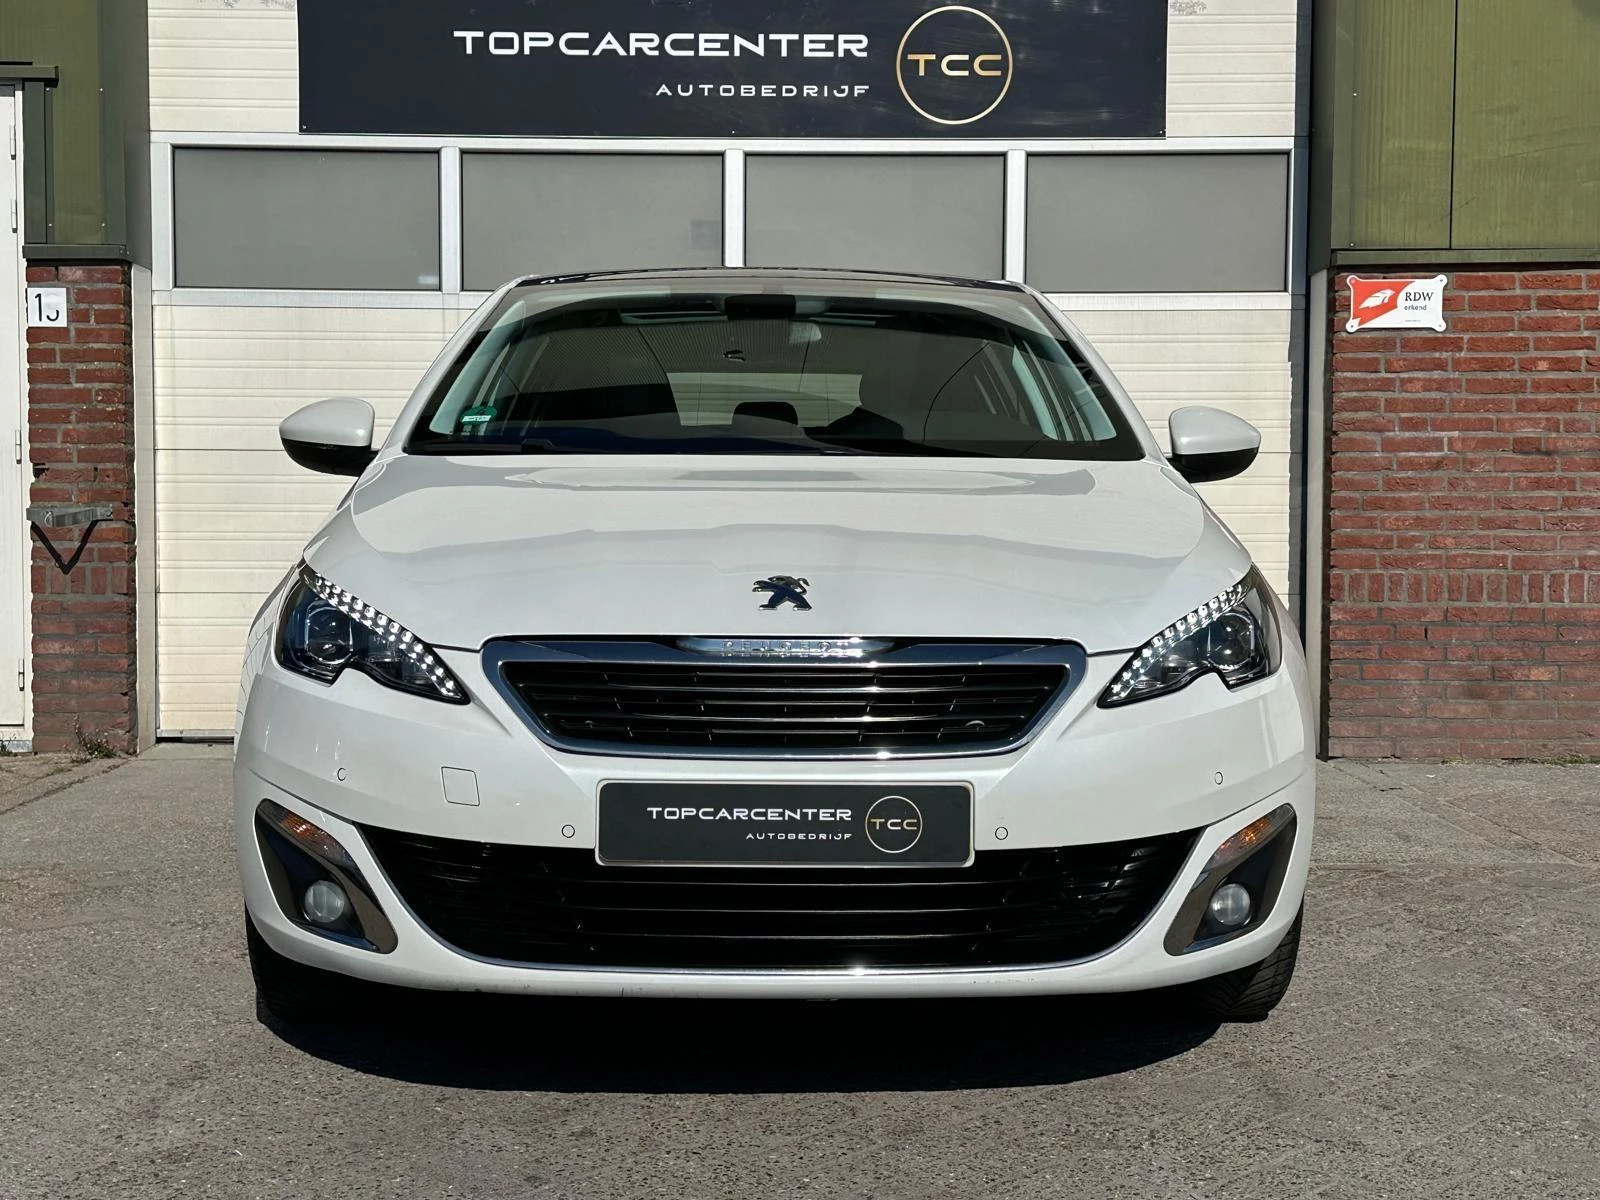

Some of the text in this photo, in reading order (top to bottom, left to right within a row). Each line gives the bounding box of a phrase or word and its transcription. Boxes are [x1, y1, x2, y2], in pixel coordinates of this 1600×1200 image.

[453, 30, 868, 58] TOPCARCENTER
[906, 53, 1002, 77] TCC
[655, 83, 869, 98] AUTOBEDRIJF
[1404, 291, 1434, 302] RDW
[646, 807, 852, 822] TOPCARCENTER
[871, 818, 918, 831] TCC
[745, 832, 853, 841] AUTOBEDRIJF
